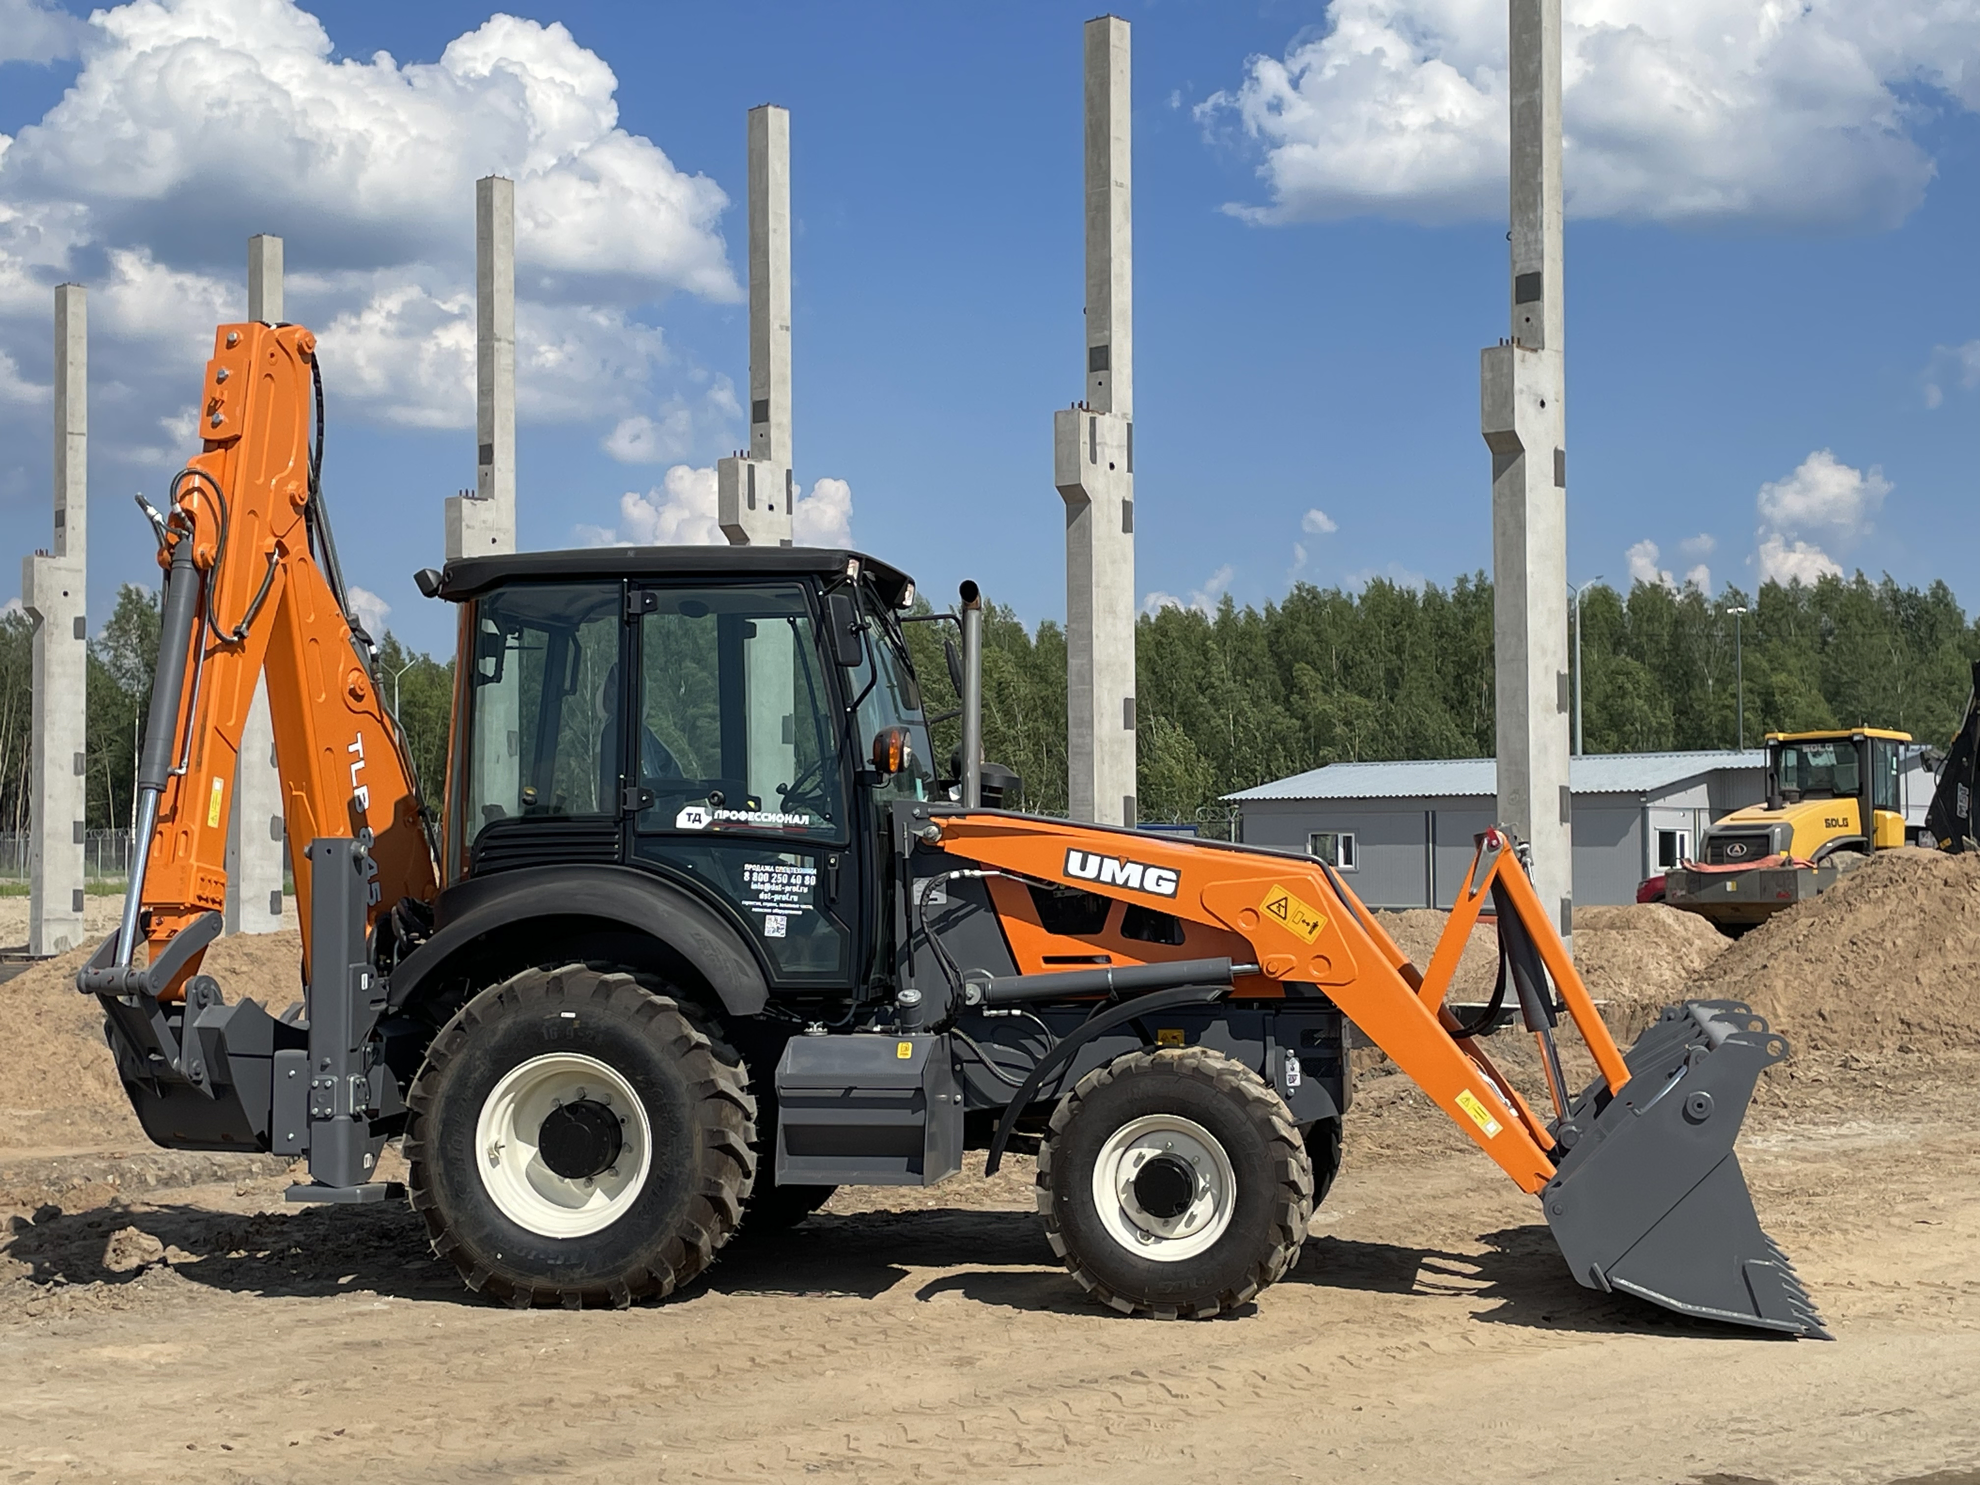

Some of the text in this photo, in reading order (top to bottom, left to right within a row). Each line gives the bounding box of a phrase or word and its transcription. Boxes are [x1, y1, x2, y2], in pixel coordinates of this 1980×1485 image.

[347, 731, 370, 814] TLB
[685, 809, 809, 825] ТД ПРОФЕССИОНАЛ
[1824, 818, 1849, 828] SDLG
[743, 863, 774, 872] ПРОДАЖА
[1066, 850, 1178, 895] UMG
[743, 871, 816, 886] 8 800 250 40 80
